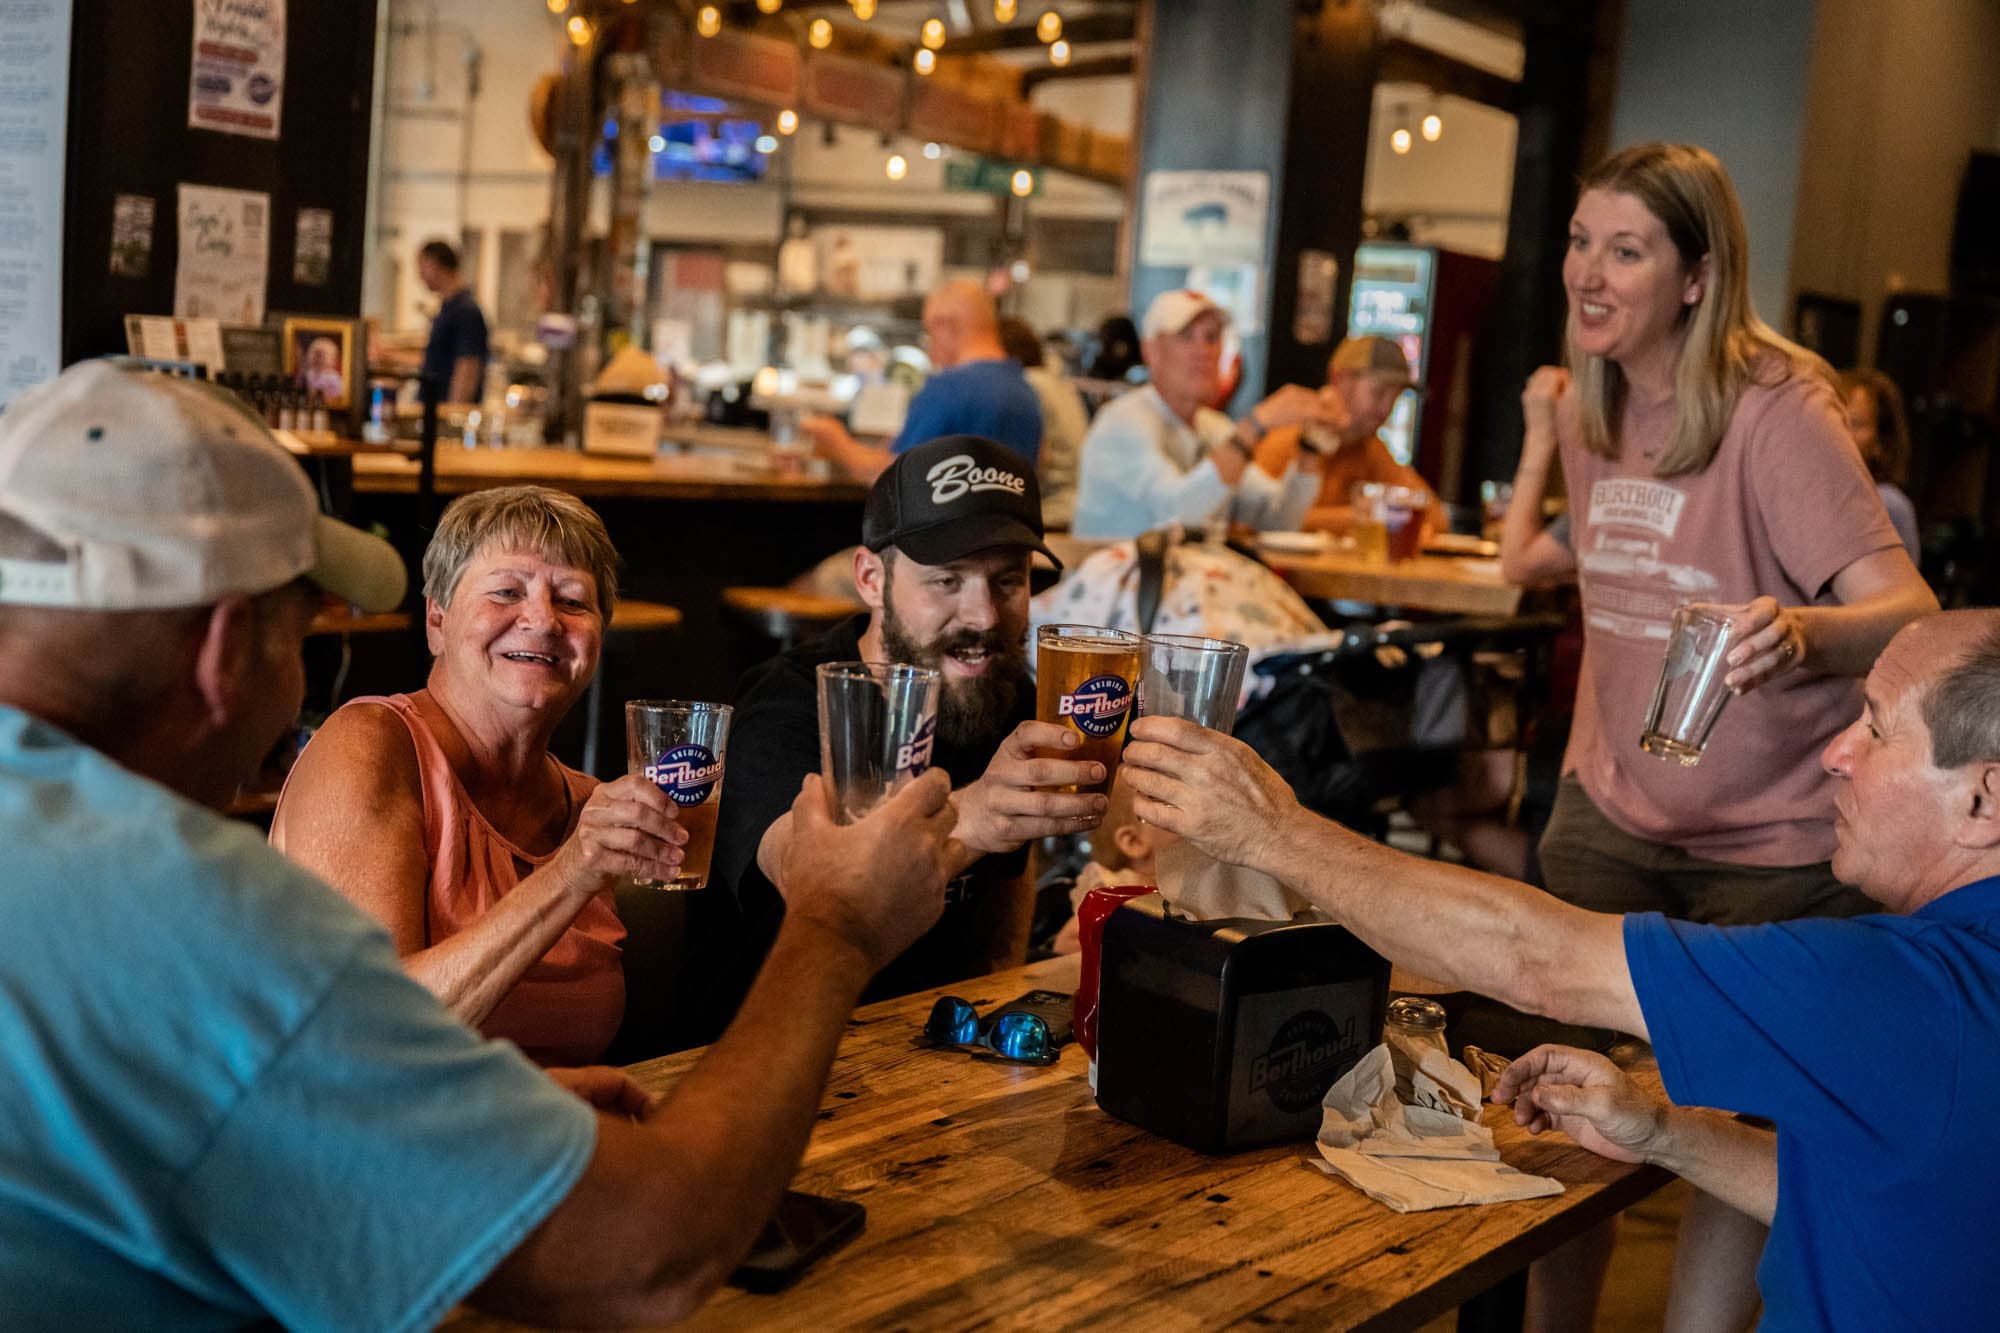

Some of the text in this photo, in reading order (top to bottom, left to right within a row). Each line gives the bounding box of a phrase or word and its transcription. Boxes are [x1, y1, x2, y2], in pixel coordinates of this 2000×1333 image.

[926, 454, 1025, 504] Boone
[645, 751, 723, 785] Berthoud
[668, 789, 704, 802] COMPANY
[1249, 1015, 1356, 1092] Berthoud
